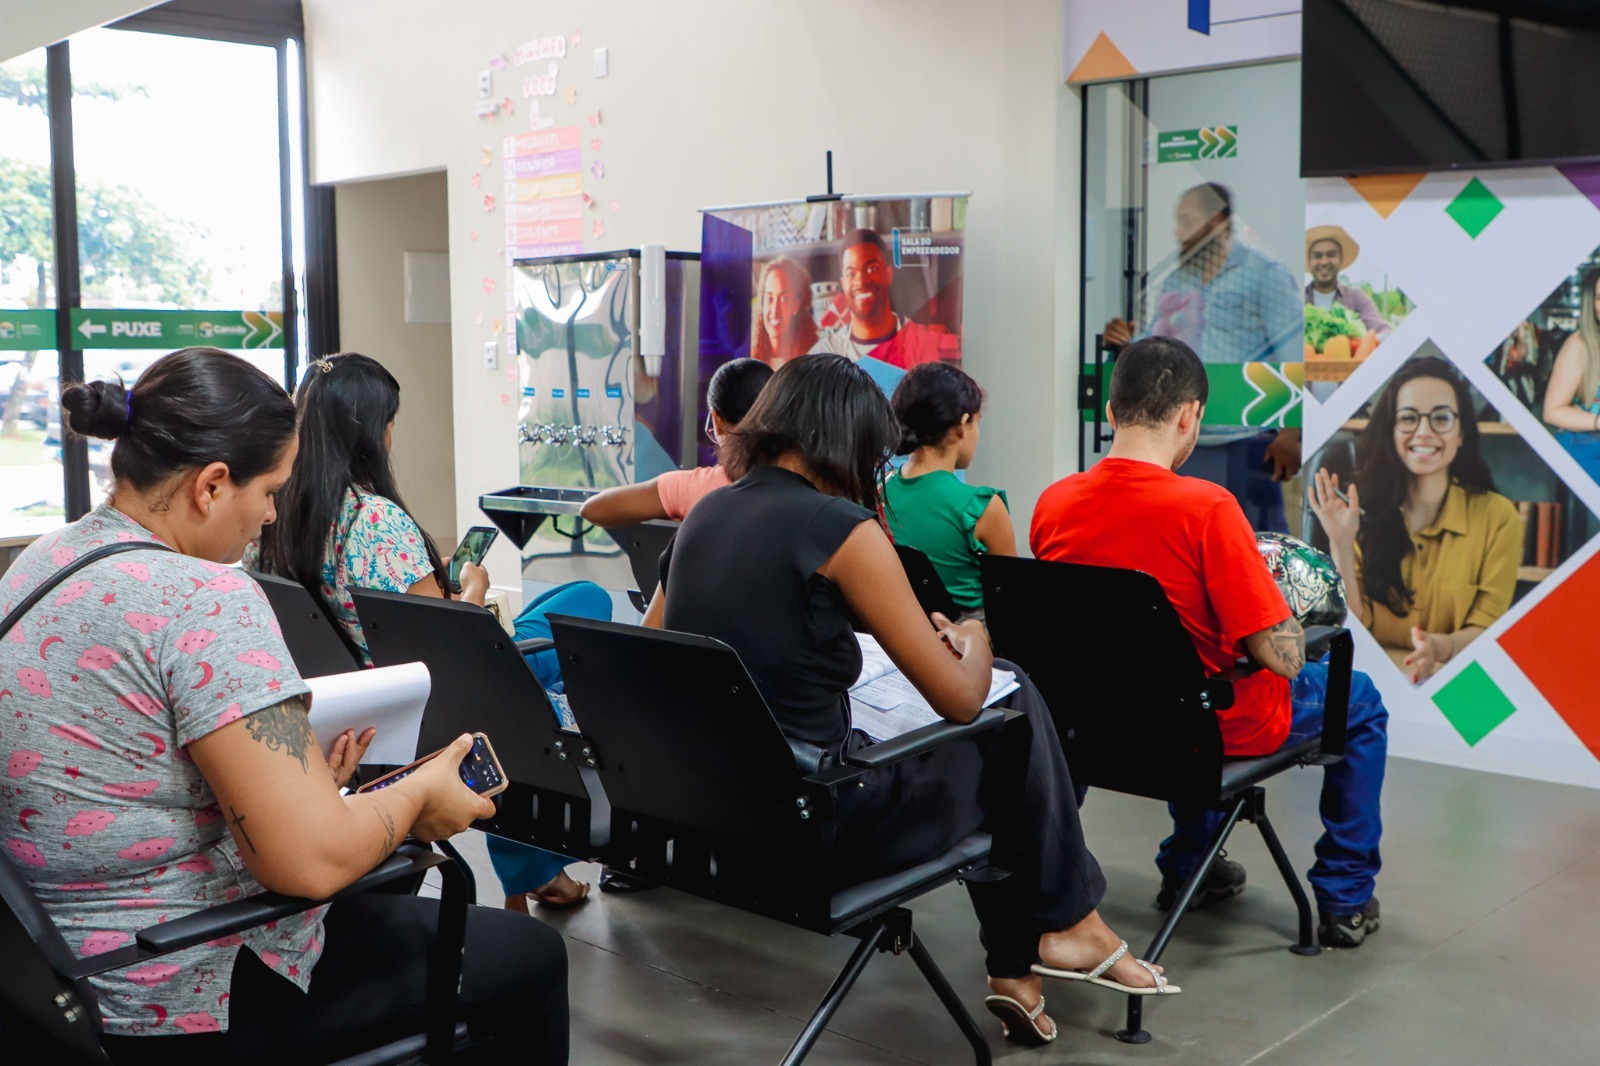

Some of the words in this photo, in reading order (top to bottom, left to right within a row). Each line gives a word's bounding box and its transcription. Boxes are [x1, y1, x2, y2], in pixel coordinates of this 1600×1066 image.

[902, 238, 920, 246] SALA
[921, 238, 931, 246] DO
[902, 247, 960, 255] EMPREENDEDOR
[112, 322, 162, 337] PUXE
